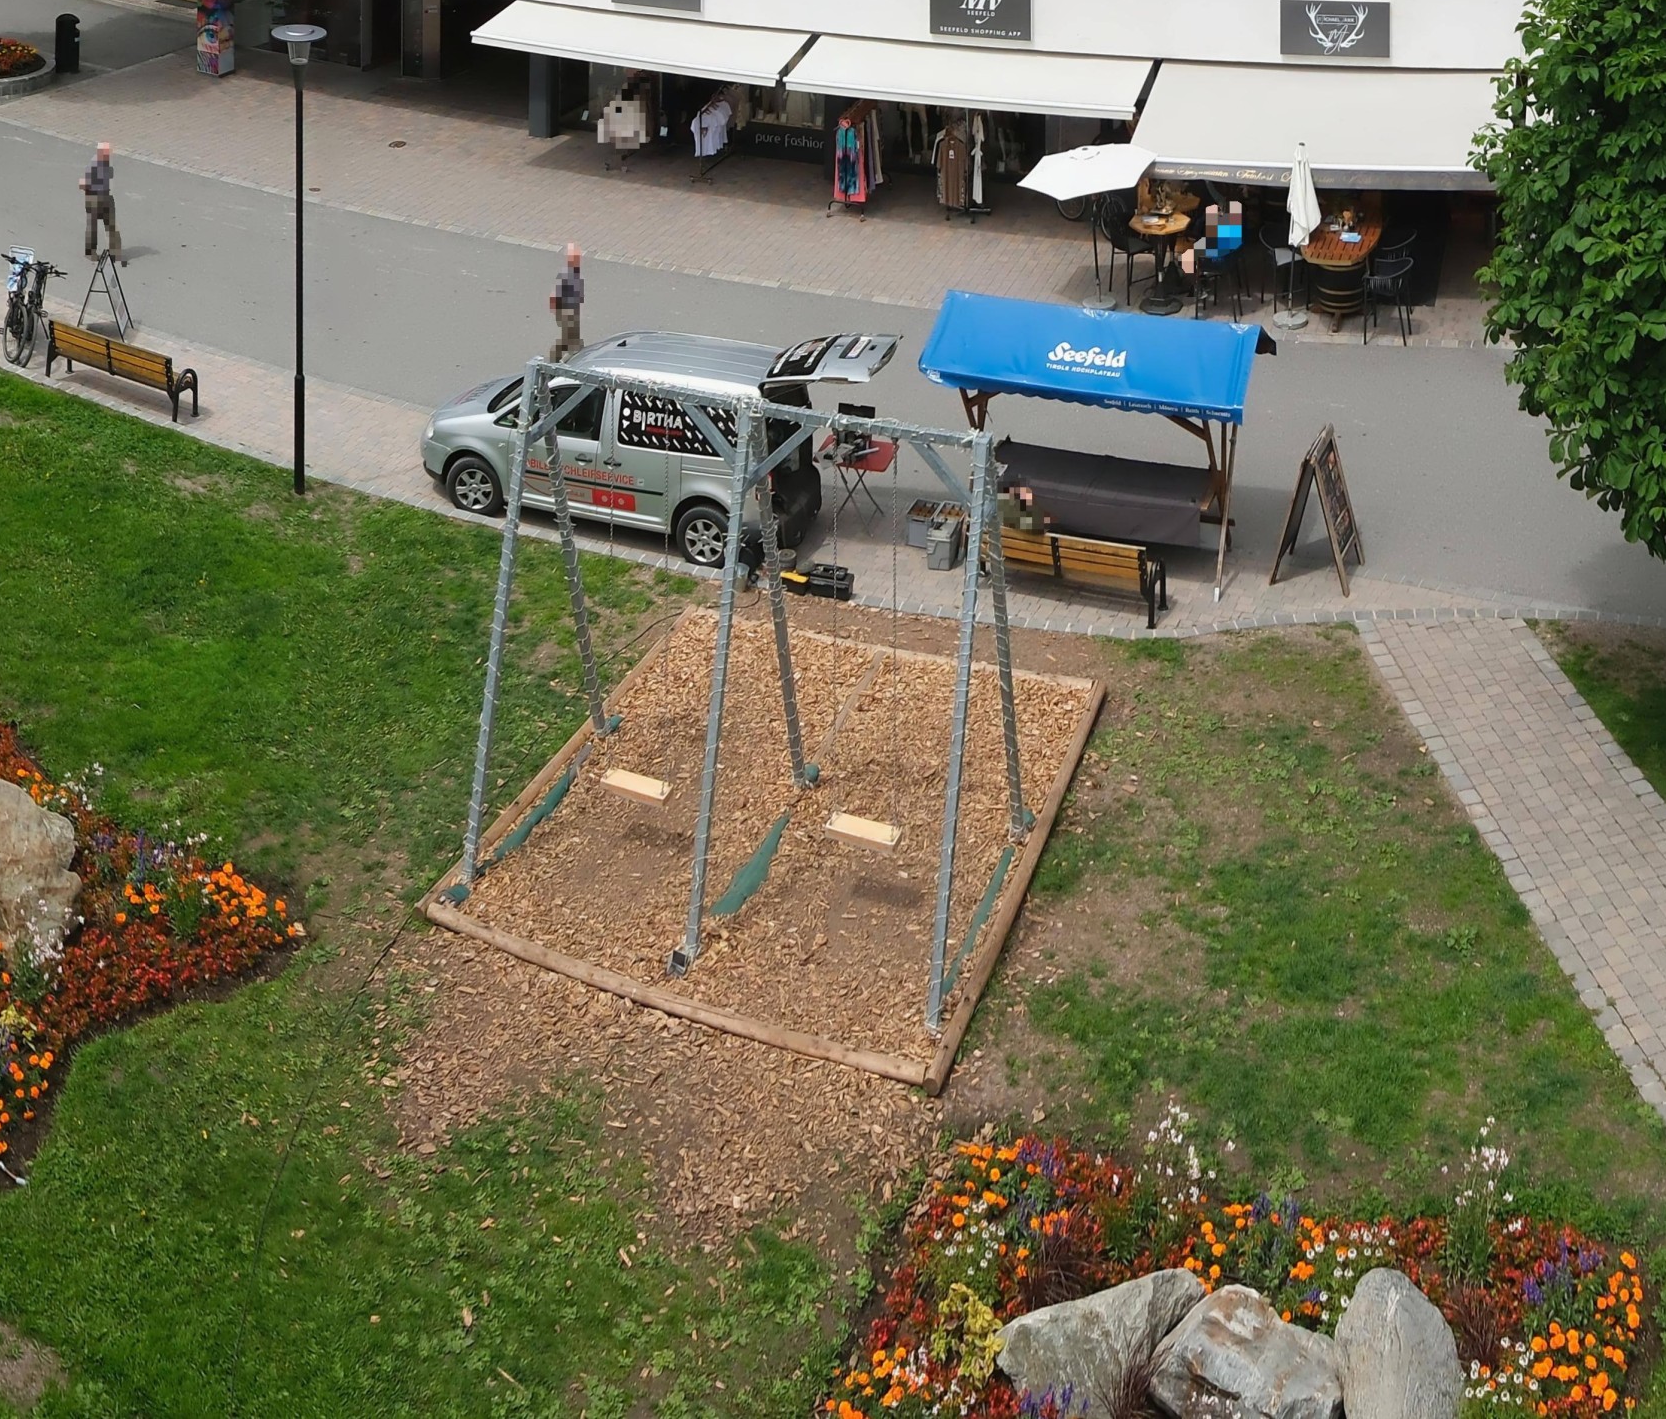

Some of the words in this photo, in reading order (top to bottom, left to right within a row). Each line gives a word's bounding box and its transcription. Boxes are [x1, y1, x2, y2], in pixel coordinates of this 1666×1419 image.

[939, 25, 968, 33] SEEFELD
[971, 27, 1006, 36] SHOPPING
[755, 133, 782, 148] pure
[1047, 341, 1128, 368] Seefeld
[1045, 362, 1070, 371] TIROLS
[1071, 367, 1121, 378] HOCHPLATEAU
[561, 465, 635, 485] CHLEIFSERVICE
